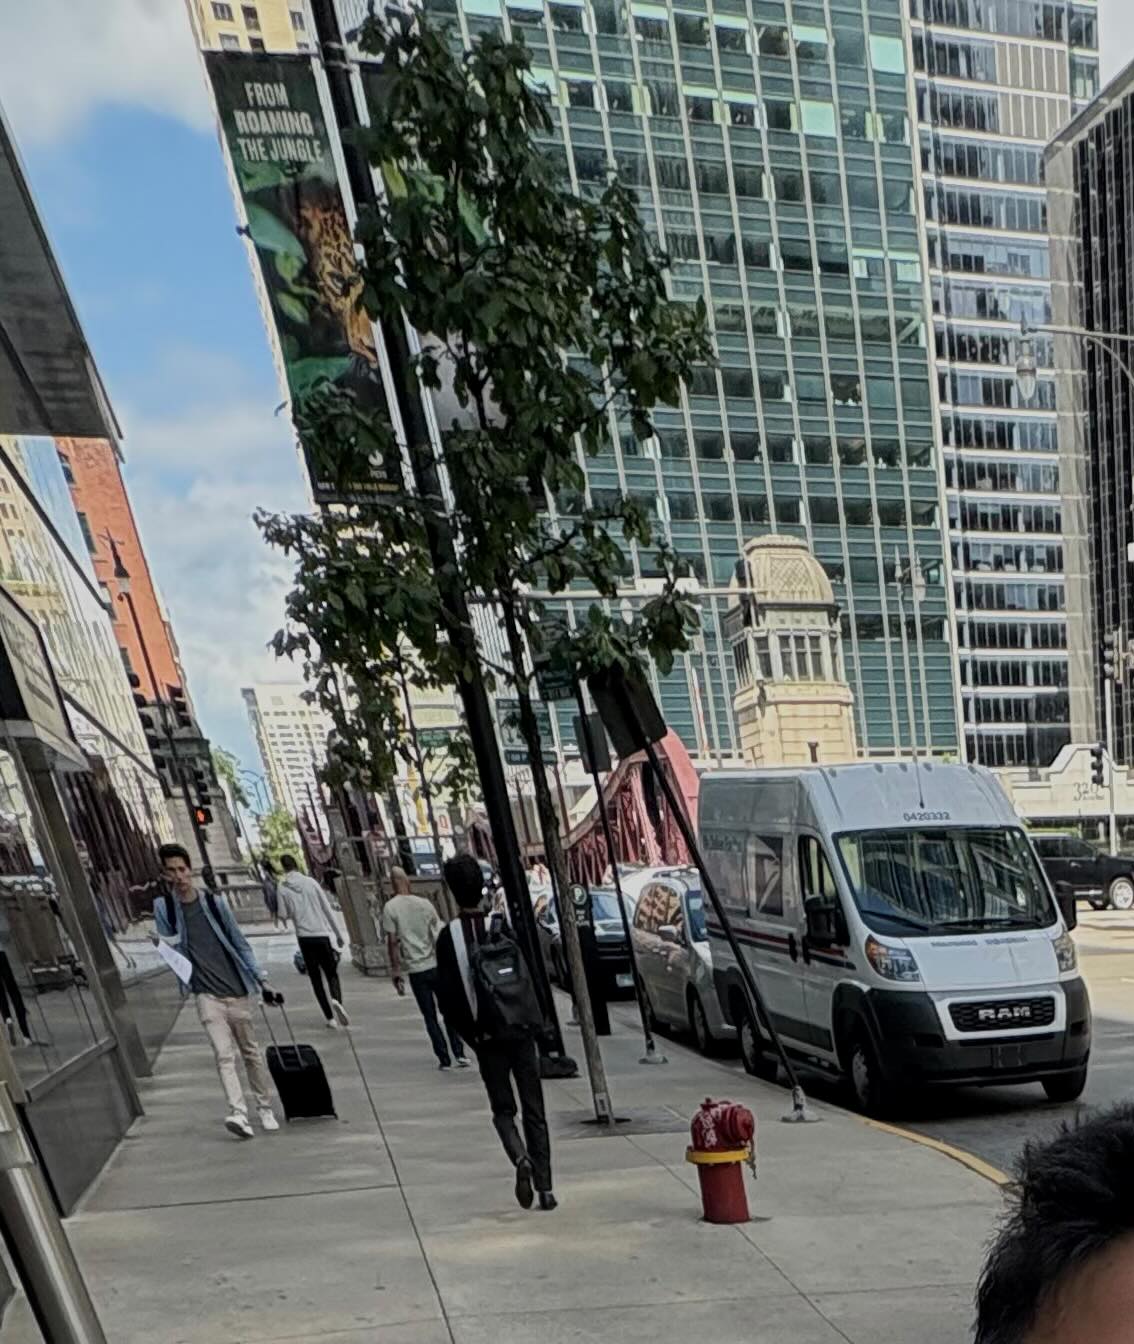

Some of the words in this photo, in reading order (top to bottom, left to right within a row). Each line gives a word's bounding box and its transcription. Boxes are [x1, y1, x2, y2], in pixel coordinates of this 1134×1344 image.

[244, 82, 290, 107] FROM
[233, 110, 315, 136] ROAMING
[237, 138, 269, 160] THE
[269, 137, 324, 162] JUNGLE
[978, 1006, 1031, 1020] RAM
